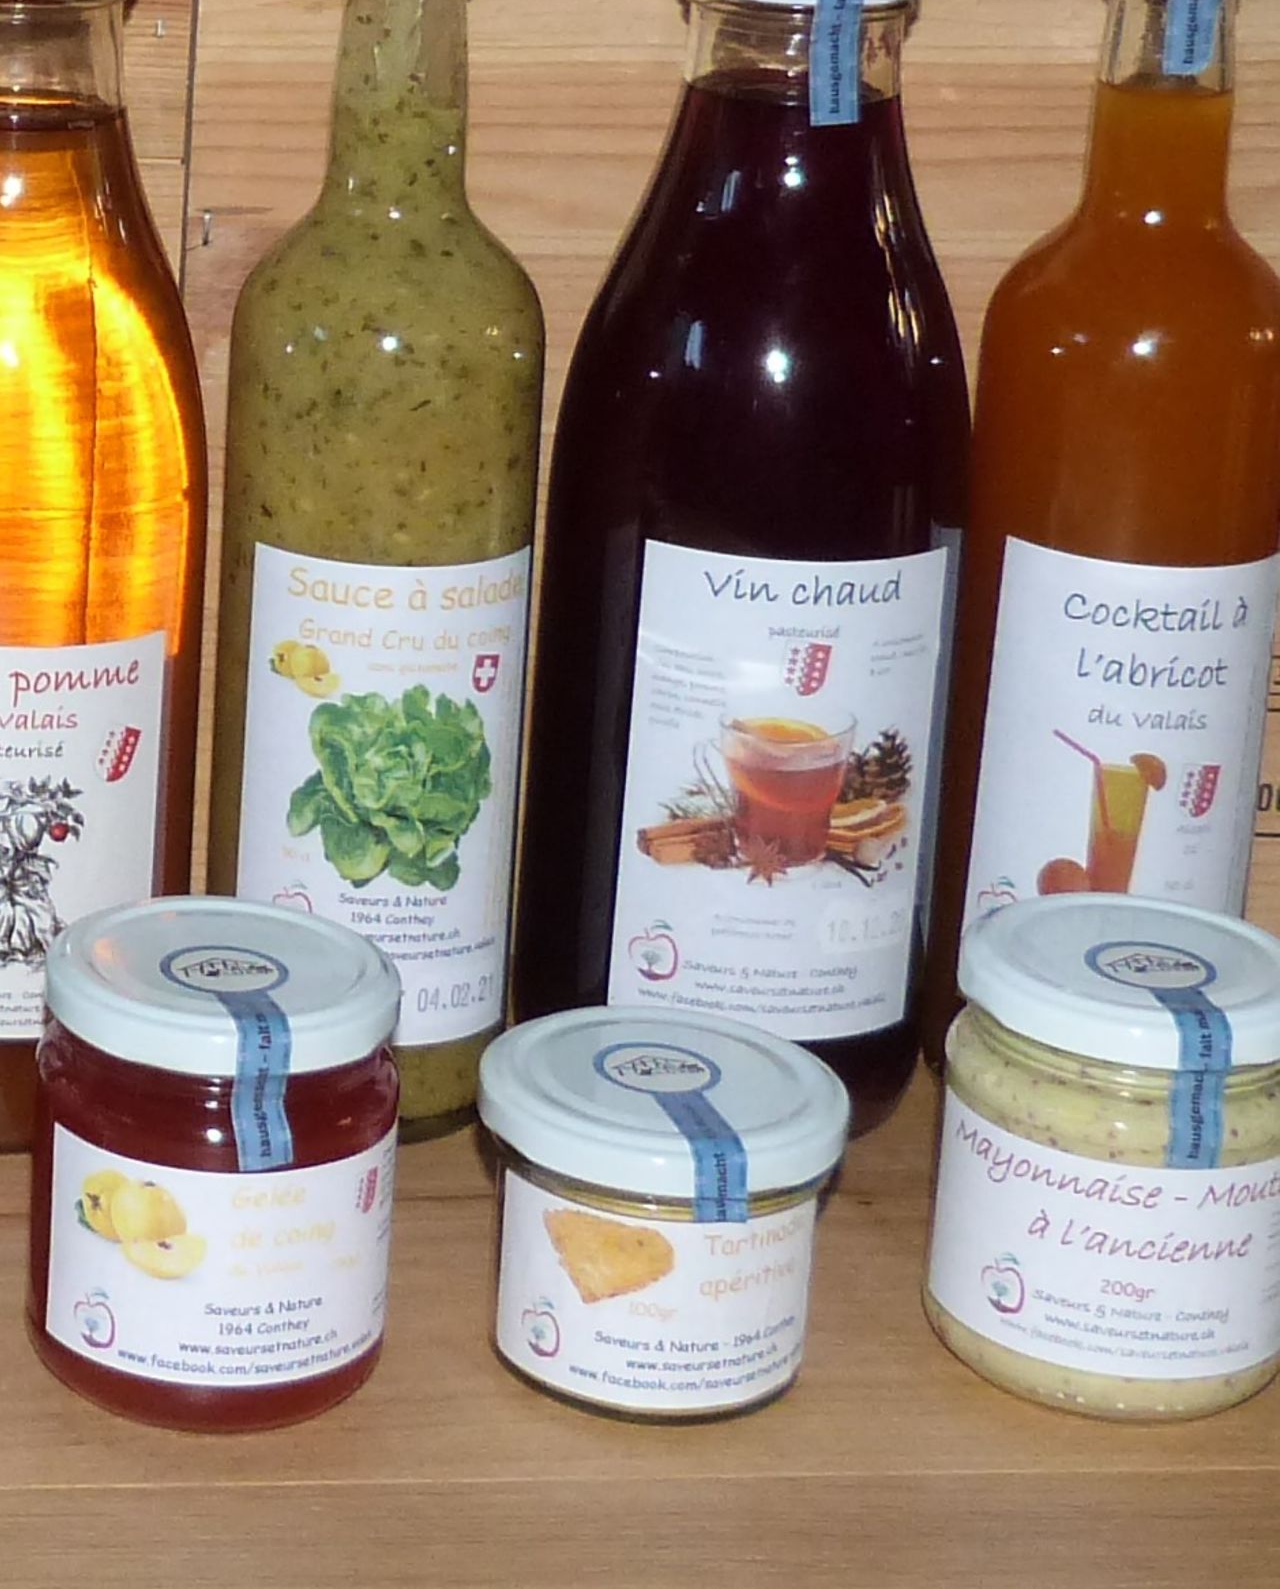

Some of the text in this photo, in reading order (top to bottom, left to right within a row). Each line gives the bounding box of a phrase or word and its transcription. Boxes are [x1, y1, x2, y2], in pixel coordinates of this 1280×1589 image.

[287, 566, 524, 611] Sauce à salade
[704, 570, 902, 606] Vin chaud
[1063, 592, 1247, 632] Cocktail à
[299, 619, 372, 649] Grand
[381, 630, 426, 651] Cru
[435, 627, 459, 651] du
[1077, 648, 1230, 688] l'abricot
[9, 660, 140, 707] pomme
[1087, 705, 1207, 730] du valais
[338, 892, 448, 908] Saveurs Nature
[350, 911, 434, 928] 1964 Conthey
[258, 1023, 271, 1050] fait
[956, 1119, 1280, 1209] Mayonnaise Mout
[230, 1227, 263, 1249] de
[1028, 1209, 1253, 1263] à l'ancienne
[1100, 1279, 1155, 1302] 200gr
[204, 1295, 323, 1317] Saveurs Nature
[219, 1317, 310, 1336] 1964 Conthey
[594, 1331, 761, 1353] Saveurs Nature 1964
